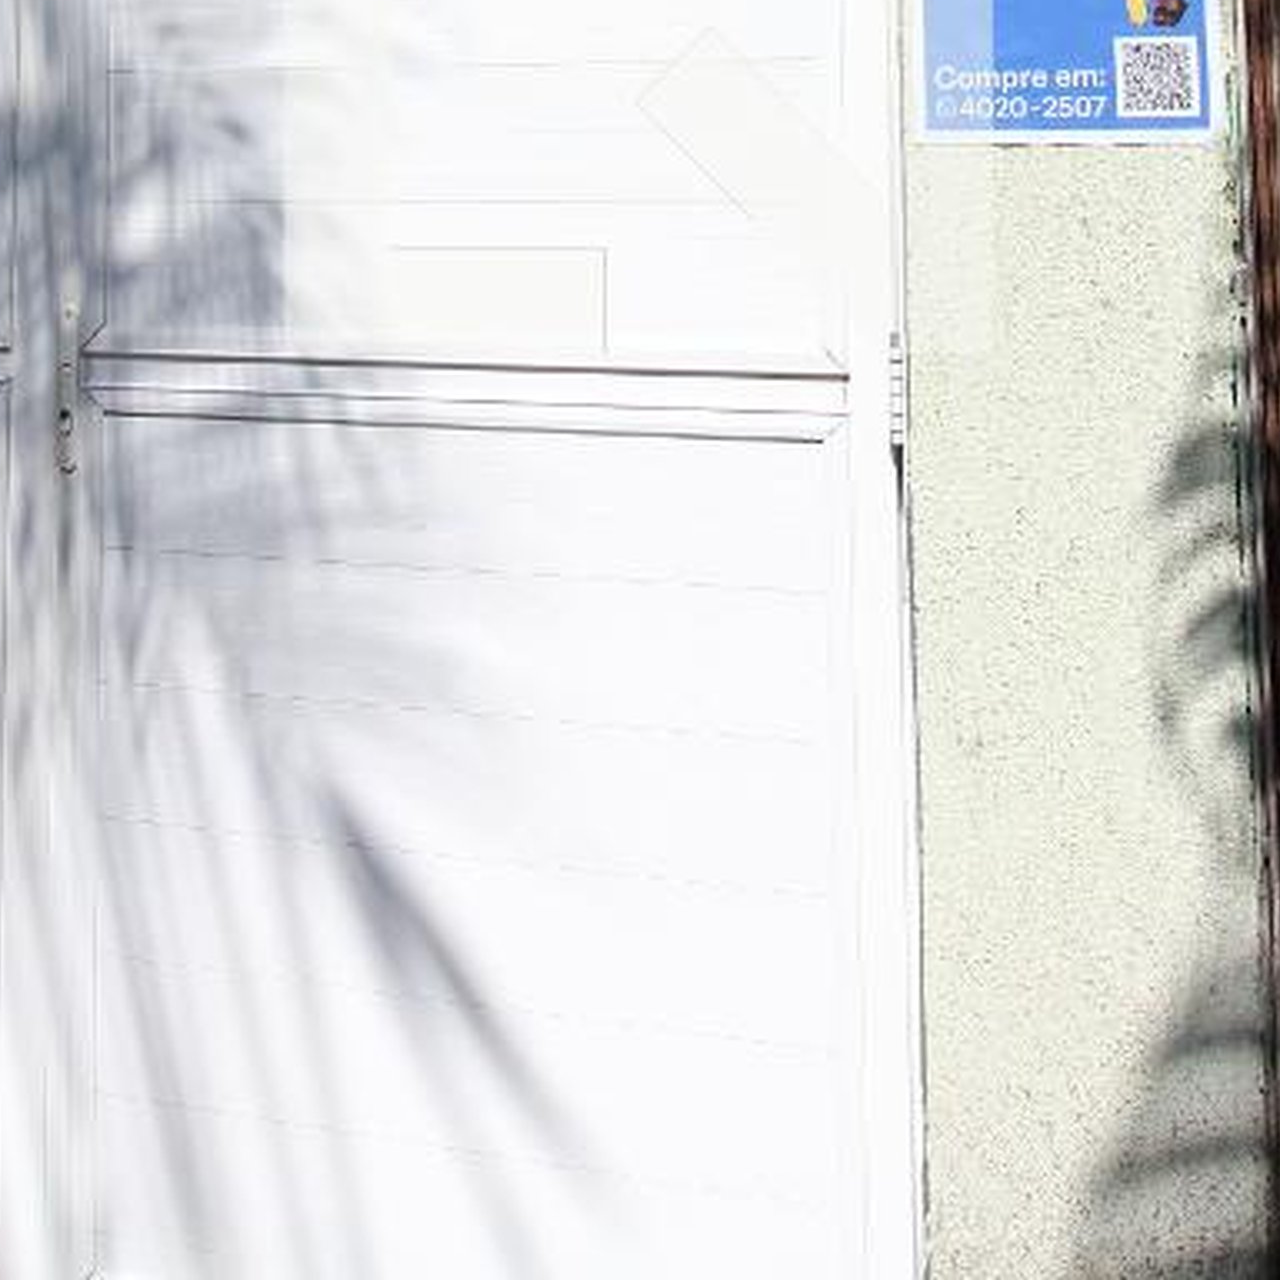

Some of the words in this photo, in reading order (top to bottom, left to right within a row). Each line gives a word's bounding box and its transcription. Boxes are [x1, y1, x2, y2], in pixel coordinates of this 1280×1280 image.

[934, 65, 1048, 93] Compre
[1055, 68, 1106, 88] em:
[959, 95, 1106, 119] 4020-2507
